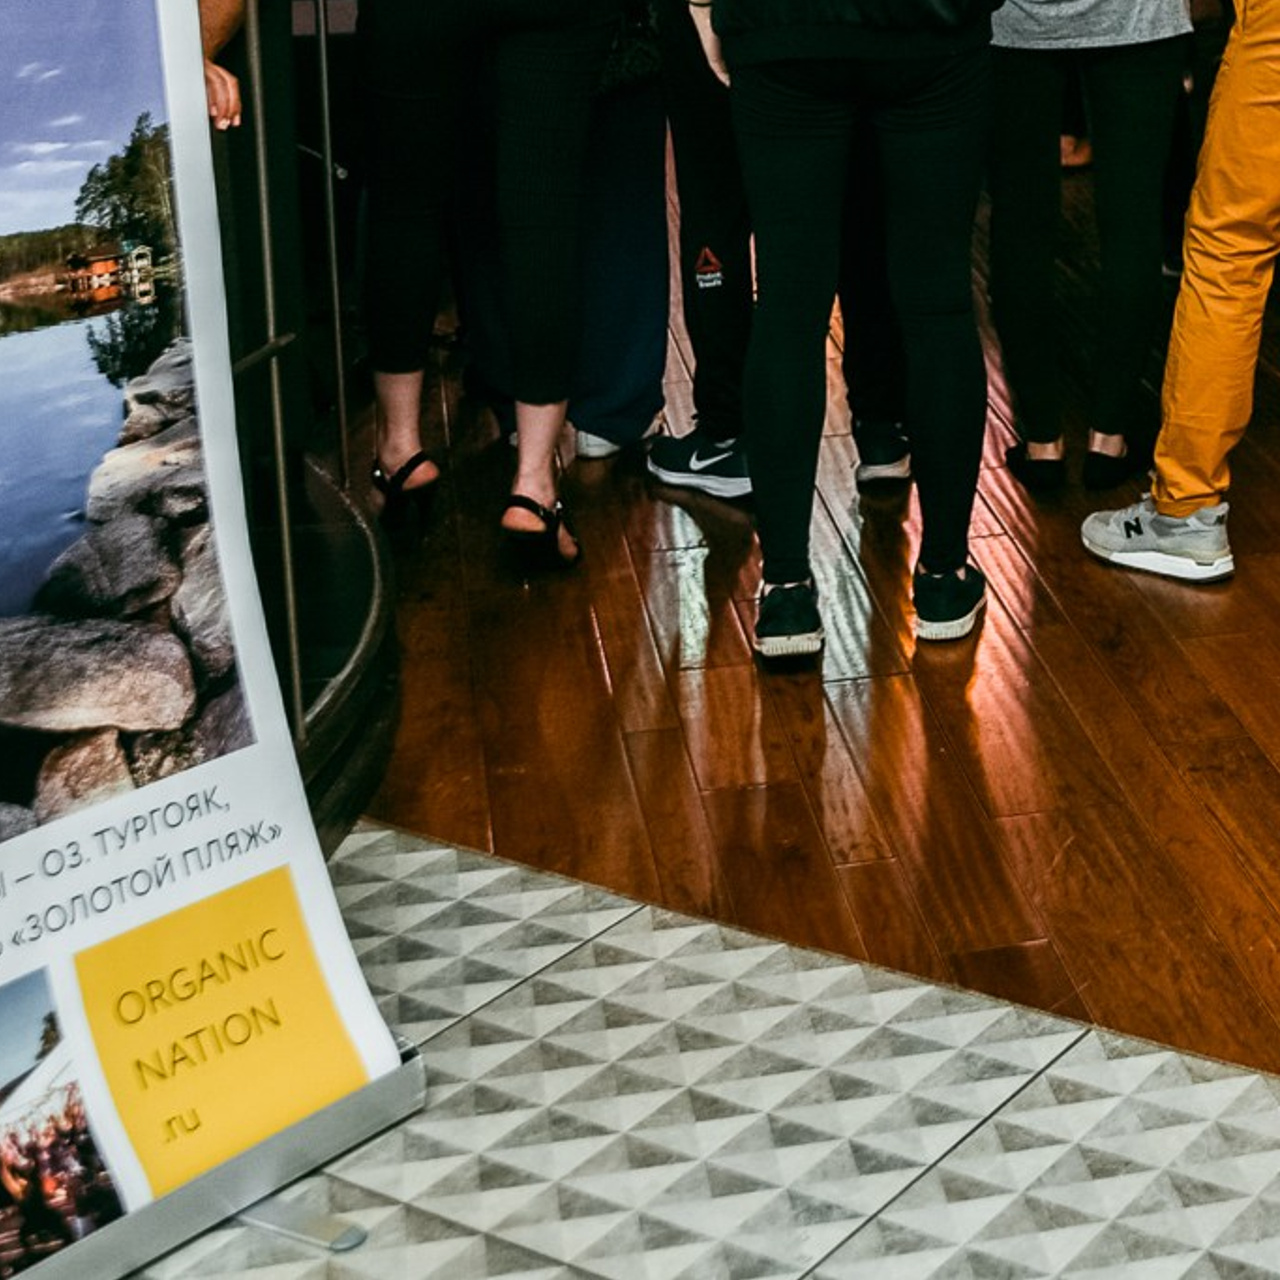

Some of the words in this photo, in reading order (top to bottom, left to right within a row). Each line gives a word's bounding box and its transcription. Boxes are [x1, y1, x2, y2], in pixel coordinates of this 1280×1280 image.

[1123, 517, 1144, 539] N
[41, 840, 91, 877] ОЗ.
[92, 785, 231, 856] ТУРГОЯК,
[11, 853, 176, 947] «ЗОЛОТОЙ
[182, 819, 283, 876] ПЛЯЖ»
[115, 928, 286, 1026] ORGANIC
[134, 997, 283, 1090] NATION
[164, 1107, 201, 1143] .ru
